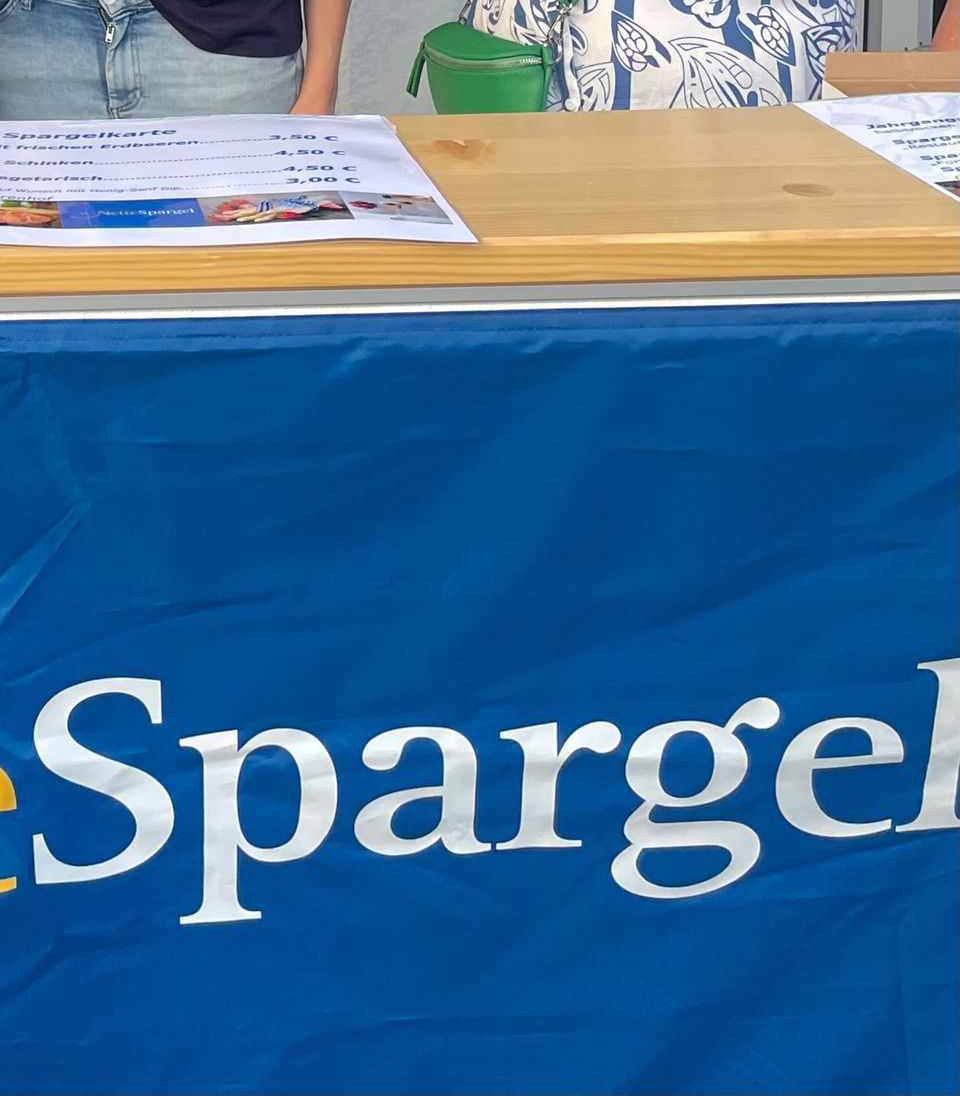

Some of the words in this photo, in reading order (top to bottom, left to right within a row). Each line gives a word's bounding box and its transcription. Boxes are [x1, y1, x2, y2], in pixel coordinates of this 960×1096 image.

[2, 129, 177, 141] Spargelkarte
[100, 140, 199, 149] Erdbeeren
[286, 176, 338, 184] 3,00
